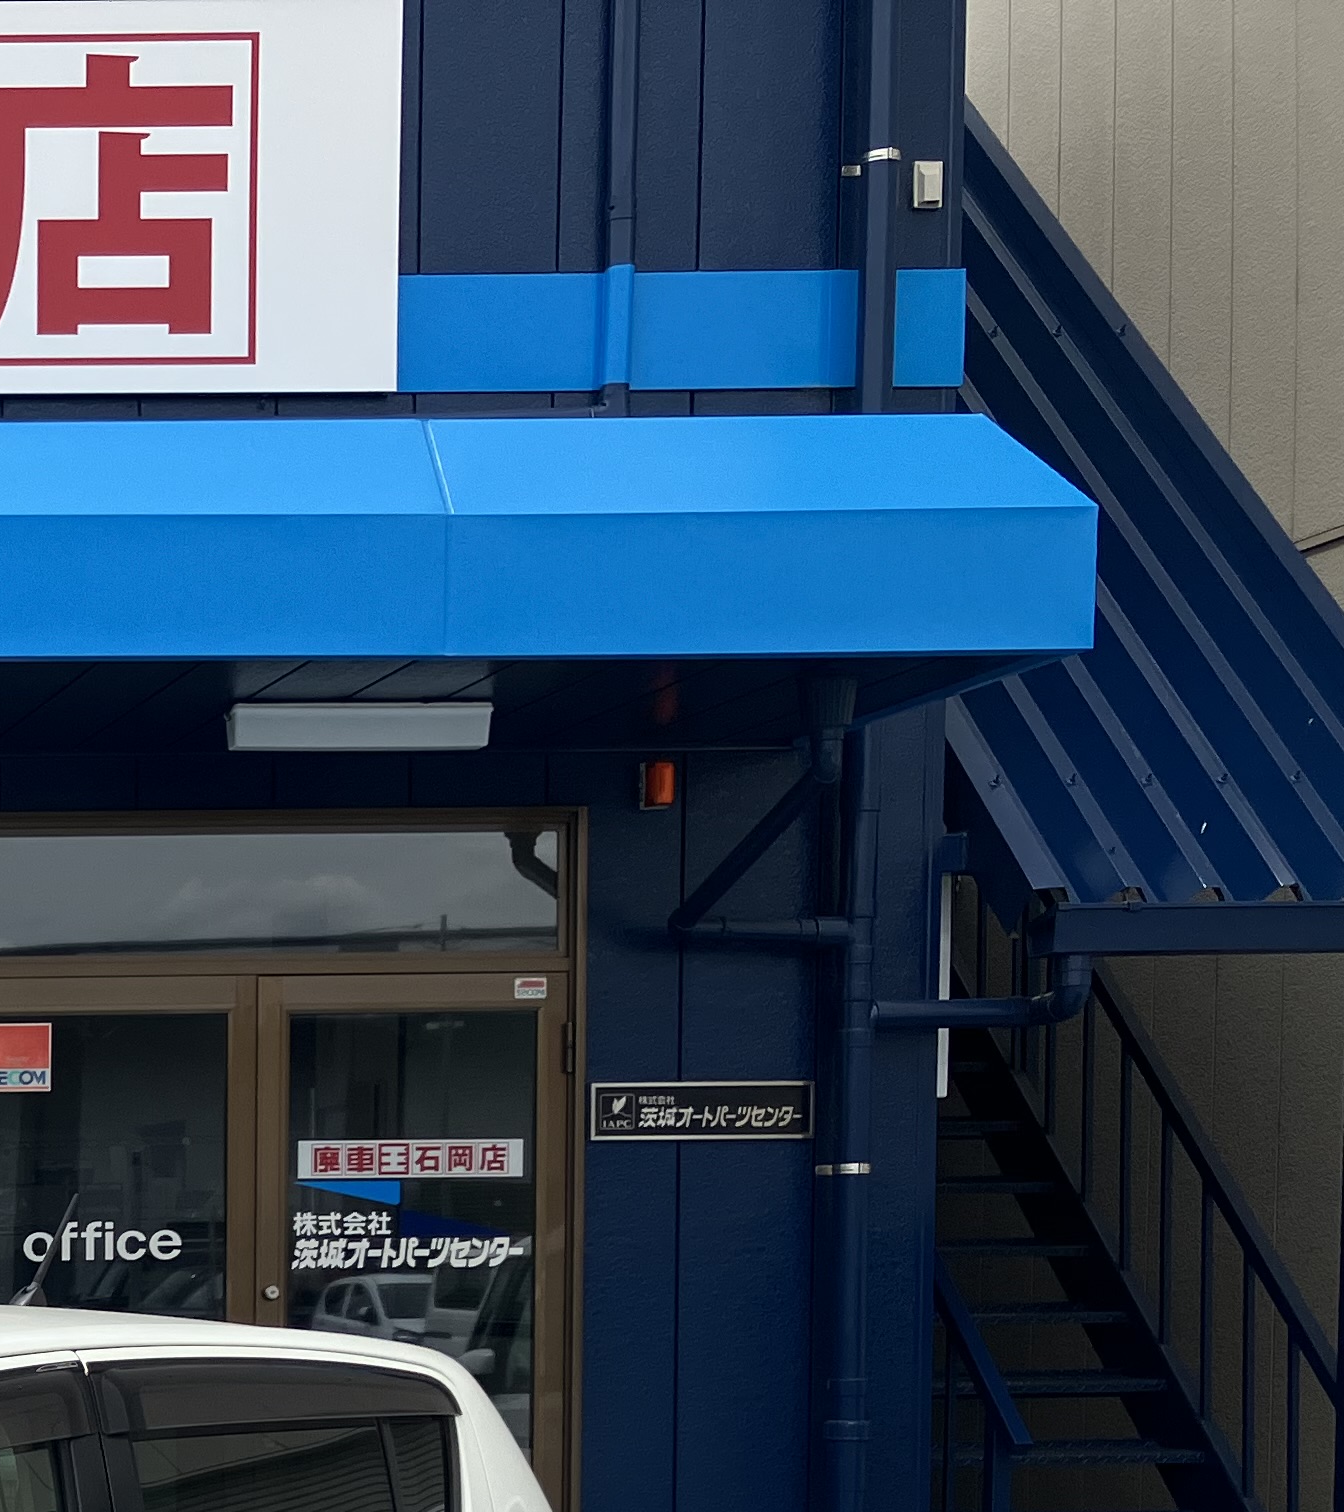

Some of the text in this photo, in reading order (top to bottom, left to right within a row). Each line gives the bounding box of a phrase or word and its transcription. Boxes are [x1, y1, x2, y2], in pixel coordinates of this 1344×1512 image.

[638, 1105, 803, 1128] 茨城オートパーツセンター
[313, 1143, 507, 1174] 廃車王石岡店
[292, 1211, 392, 1236] 株式会社
[23, 1220, 183, 1263] office
[291, 1236, 524, 1270] 茨城オートパーツセンター
